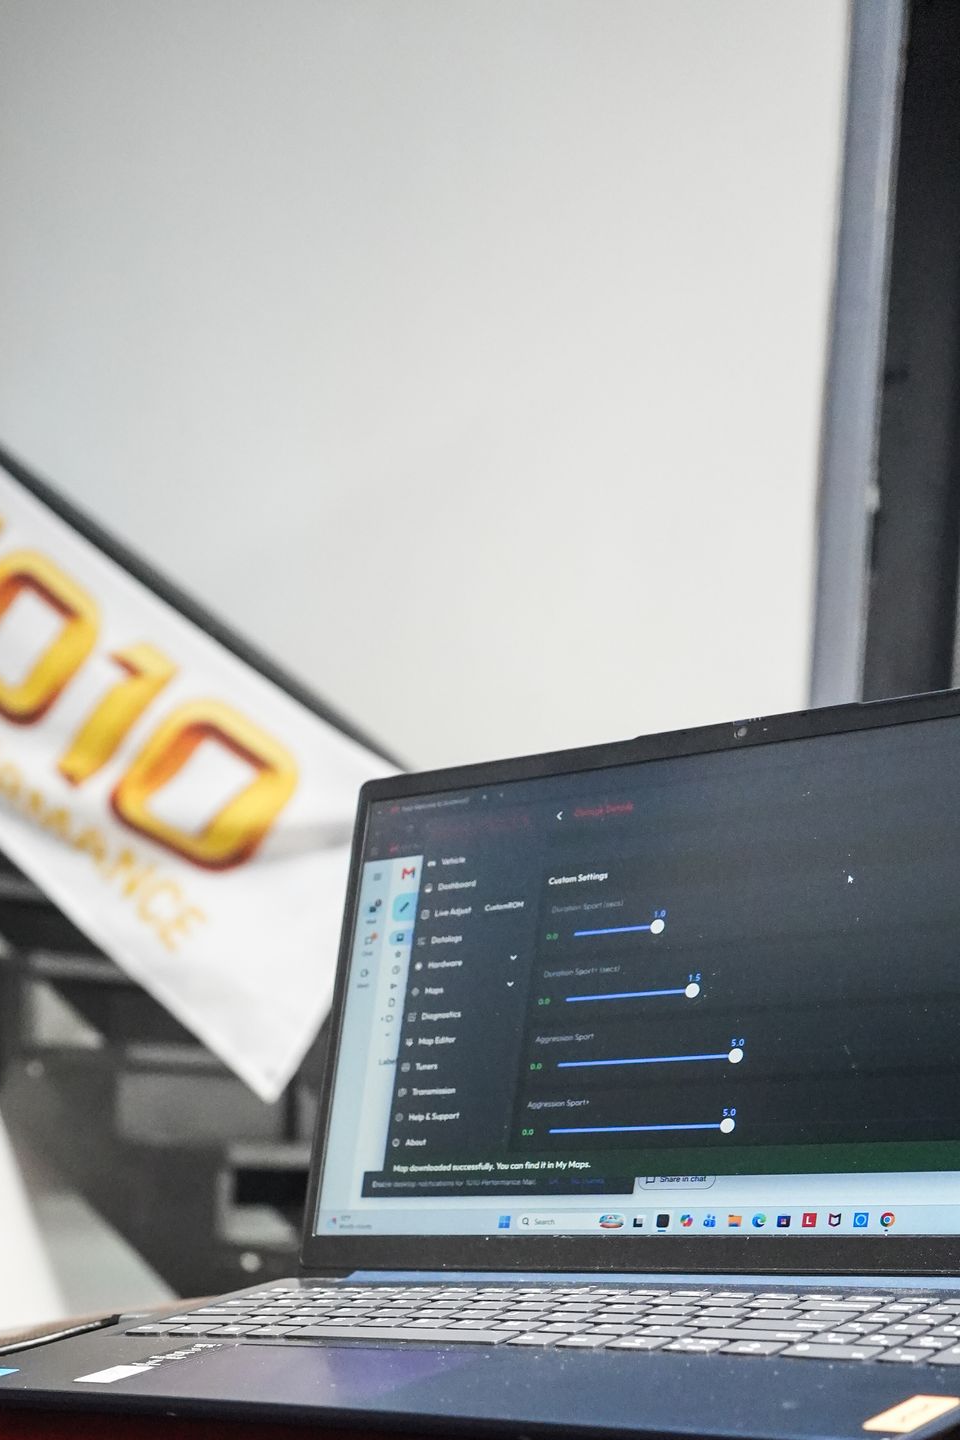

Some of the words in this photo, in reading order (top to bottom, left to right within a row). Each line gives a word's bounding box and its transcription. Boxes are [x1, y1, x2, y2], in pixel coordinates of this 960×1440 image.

[441, 856, 466, 866] Vehicle
[548, 875, 577, 886] Custom
[578, 871, 608, 883] Settings
[437, 880, 476, 892] Dashboard
[434, 909, 448, 918] Live
[450, 906, 472, 918] Adjust
[654, 910, 666, 918] 1.0
[428, 959, 463, 969] Hardware
[688, 973, 702, 982] 1.5
[424, 987, 444, 996] Maps
[538, 997, 550, 1006] 0.0
[420, 1010, 462, 1022] Diagnostics
[418, 1037, 434, 1046] Map
[435, 1036, 456, 1044] Editor
[534, 1034, 574, 1044] Aggression
[574, 1032, 594, 1042] Sport
[731, 1038, 745, 1047] 5.0
[415, 1062, 438, 1071] Tuners
[530, 1062, 542, 1070] 0.0
[412, 1087, 456, 1096] Transmission
[526, 1100, 565, 1110] Aggression
[408, 1113, 424, 1122] Help
[432, 1112, 460, 1122] Support
[722, 1108, 736, 1117] 5.0
[521, 1128, 534, 1136] 0.0
[405, 1138, 426, 1147] About
[393, 1164, 408, 1174] Map
[409, 1163, 452, 1172] downloaded
[452, 1162, 494, 1172] successfully.
[496, 1162, 508, 1170] You
[510, 1162, 523, 1170] can
[524, 1161, 539, 1170] find
[555, 1160, 567, 1171] My
[568, 1160, 591, 1170] Maps.
[534, 1218, 556, 1226] Search
